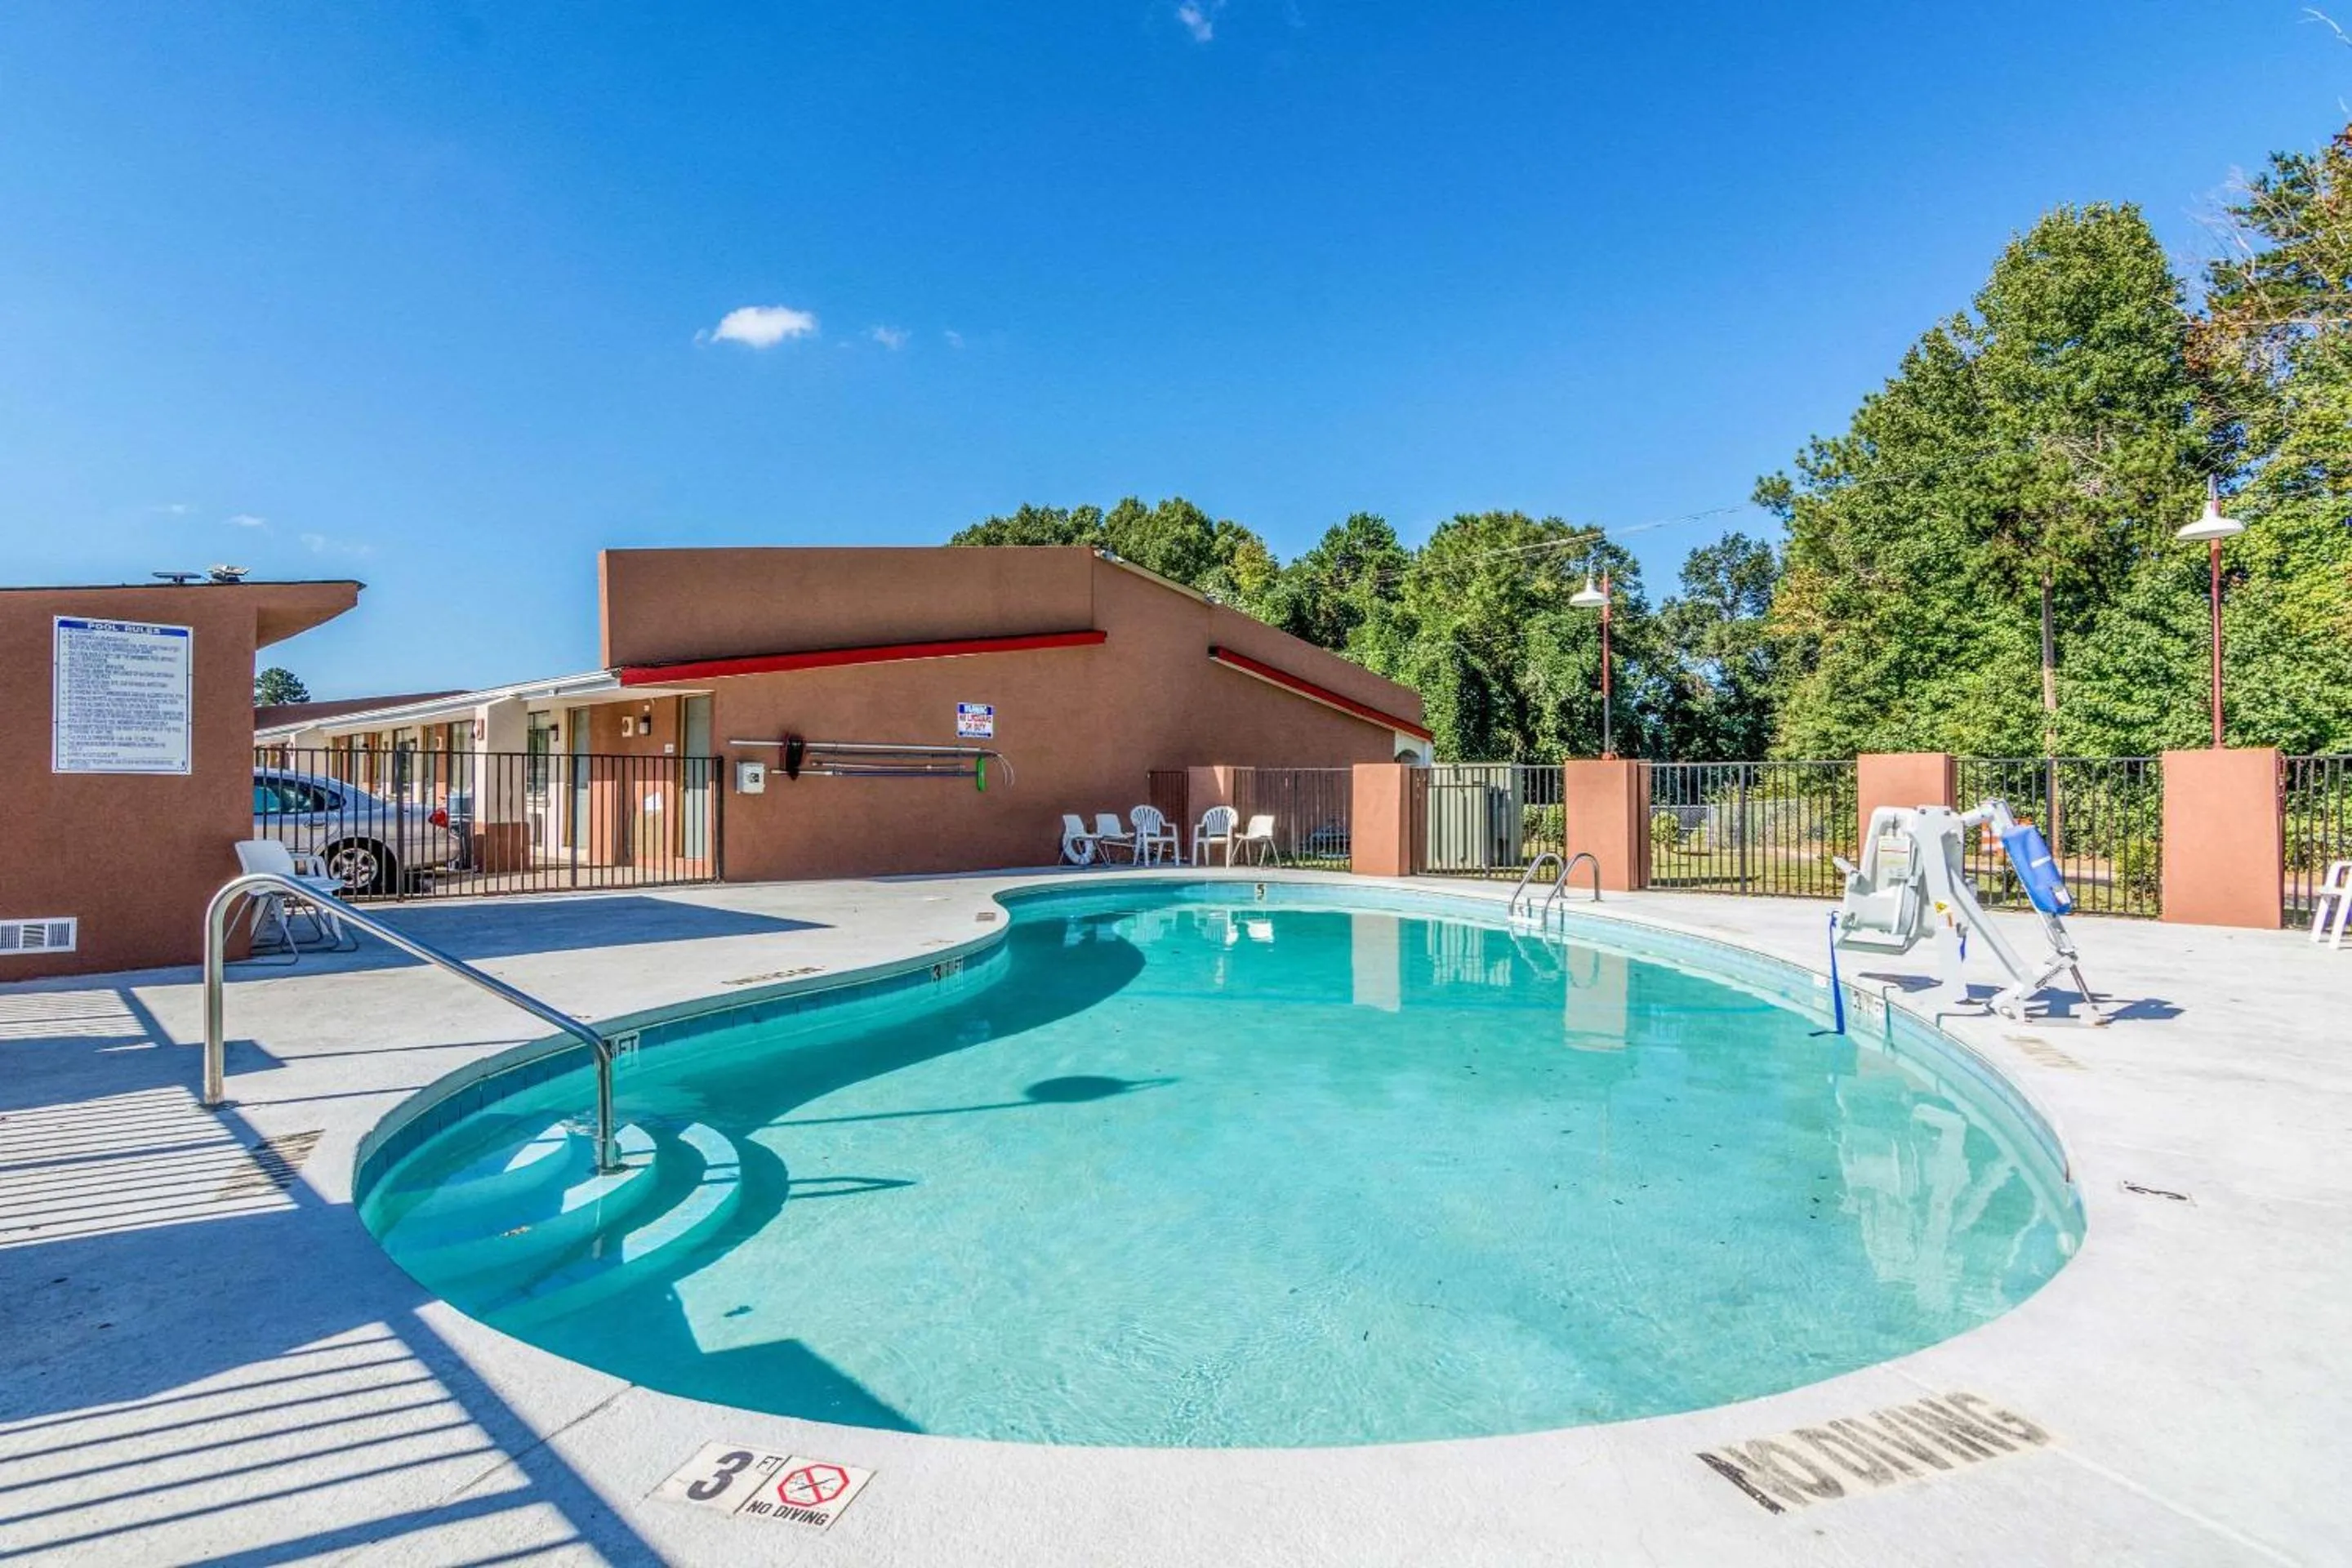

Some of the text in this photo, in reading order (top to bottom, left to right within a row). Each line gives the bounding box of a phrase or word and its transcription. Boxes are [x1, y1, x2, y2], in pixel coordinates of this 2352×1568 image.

[87, 623, 161, 635] POOL RULES
[618, 1035, 637, 1056] FT
[1695, 1392, 2051, 1516] NO DIVING
[687, 1450, 785, 1501] 3 FT
[745, 1500, 831, 1527] NO DIVING
